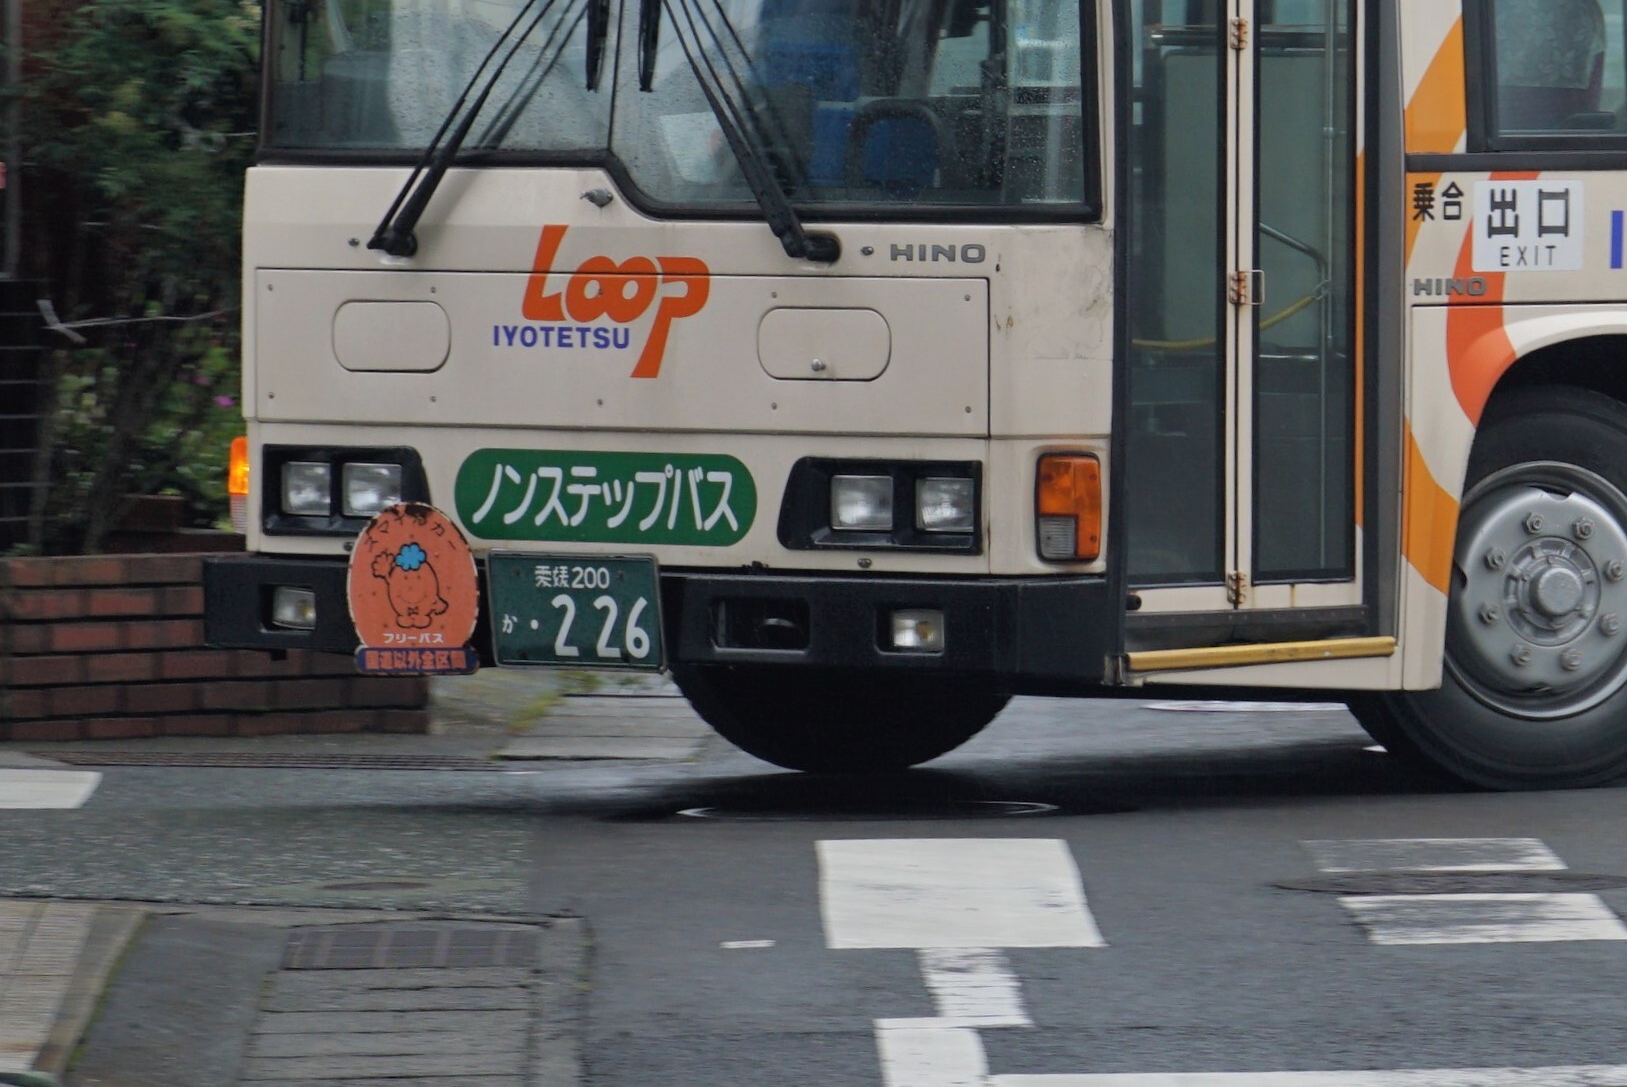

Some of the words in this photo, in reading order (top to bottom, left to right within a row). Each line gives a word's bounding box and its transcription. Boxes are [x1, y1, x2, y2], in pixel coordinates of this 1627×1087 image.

[1412, 181, 1464, 221] 乗合
[1487, 188, 1569, 238] 出口
[890, 244, 986, 263] HINO
[1500, 245, 1556, 266] EXIT
[1413, 277, 1486, 295] HINO
[493, 325, 630, 349] IYOTETSU
[472, 462, 739, 532] ノンステップバス
[502, 614, 517, 634] か
[382, 633, 444, 644] フリーバス
